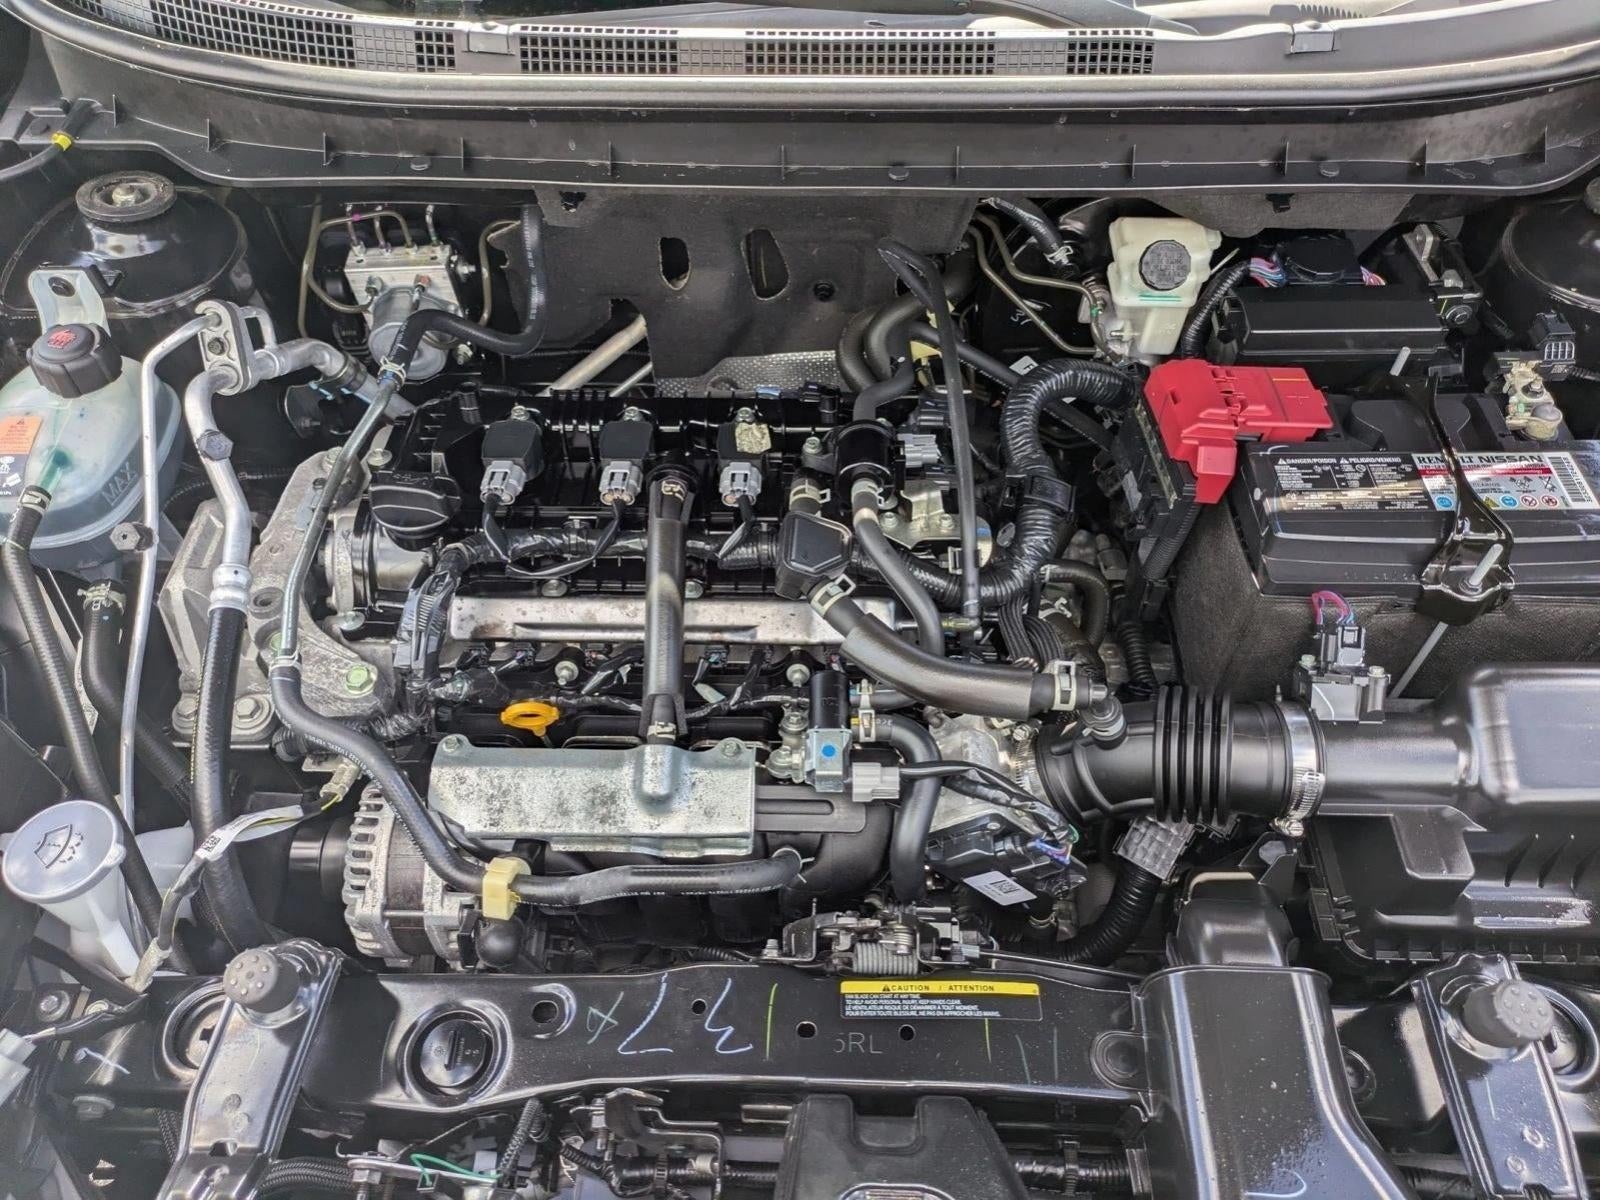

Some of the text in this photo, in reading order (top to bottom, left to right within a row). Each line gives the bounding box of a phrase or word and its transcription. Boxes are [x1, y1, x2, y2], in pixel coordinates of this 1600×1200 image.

[1417, 455, 1543, 464] RENLT NISSAN
[102, 462, 137, 506] MAX
